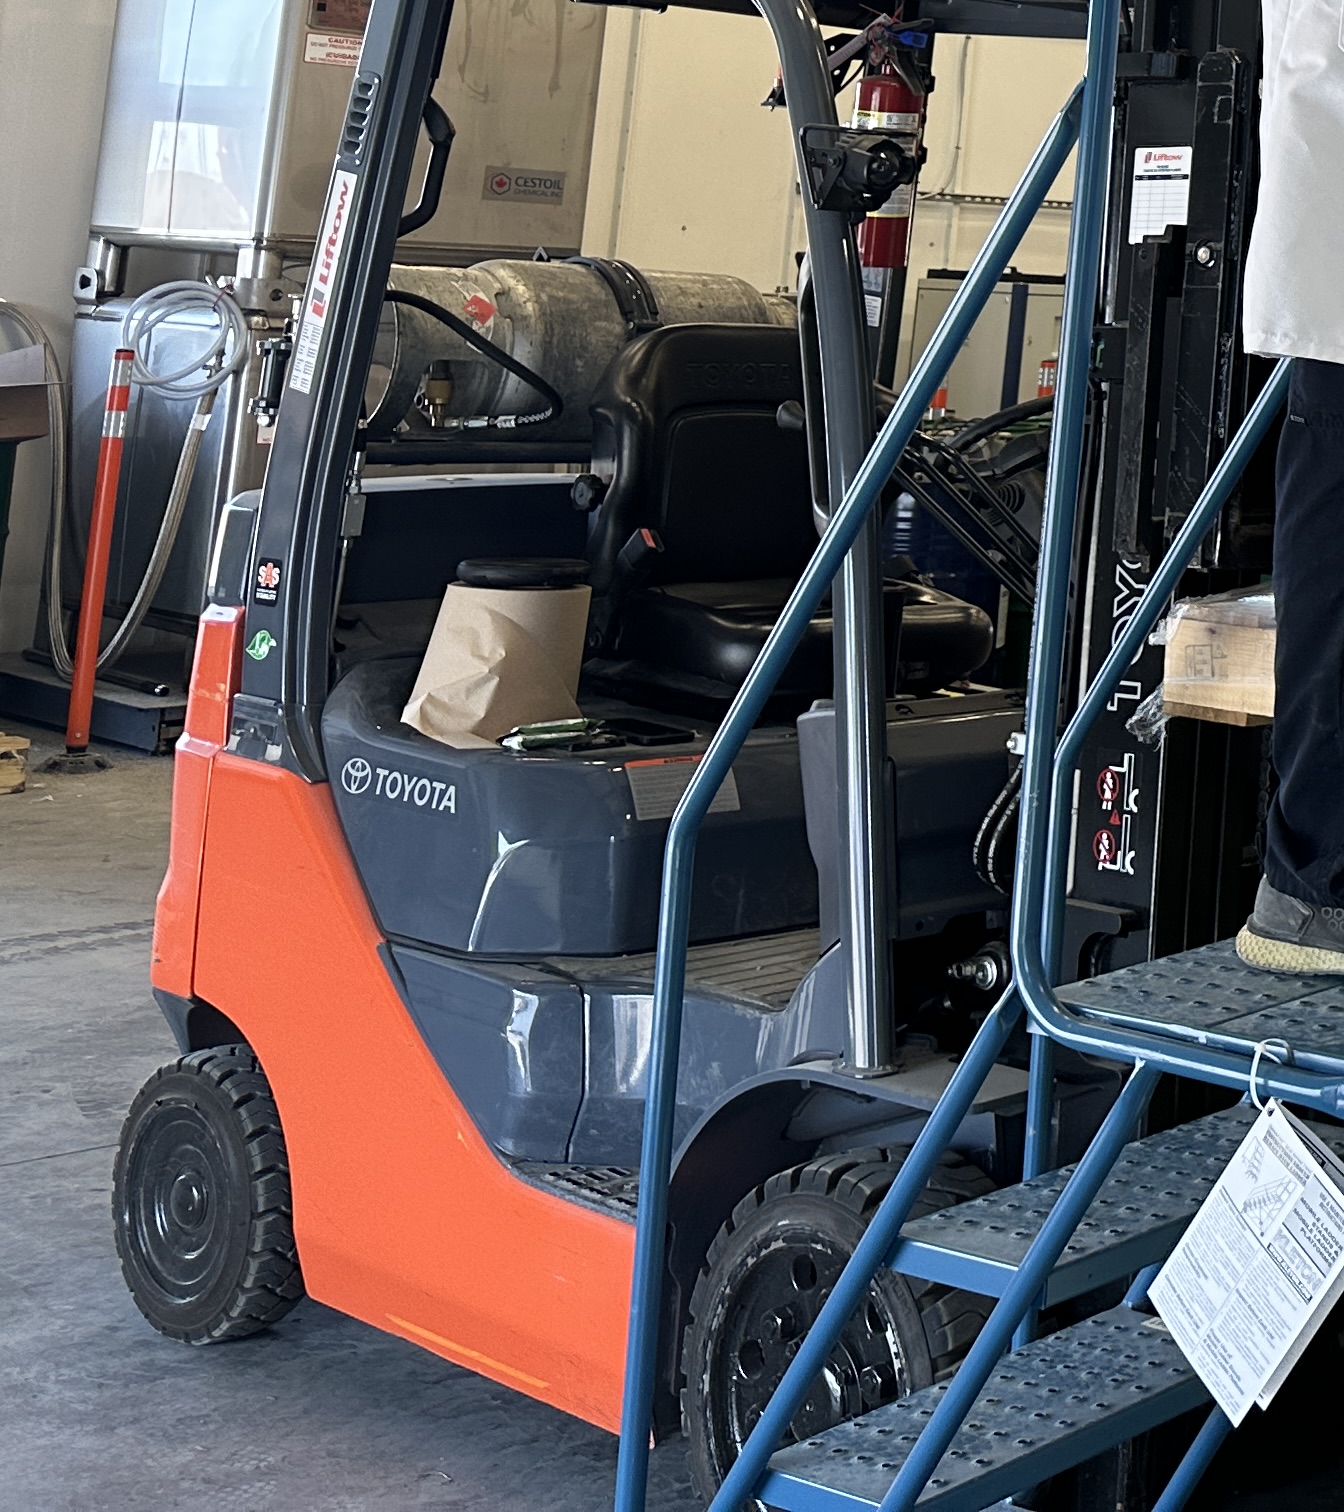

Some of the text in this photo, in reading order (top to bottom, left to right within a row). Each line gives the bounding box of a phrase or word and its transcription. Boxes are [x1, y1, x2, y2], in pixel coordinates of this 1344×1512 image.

[514, 188, 550, 197] CHEMICAL
[515, 176, 563, 190] CESTOIL
[318, 180, 349, 286] Liftow
[375, 767, 456, 814] TOYOTA
[1300, 1197, 1344, 1251] MOBILE LADDER
[1299, 1227, 1333, 1268] PLATFORMS
[1313, 1234, 1337, 1262] LADDER
